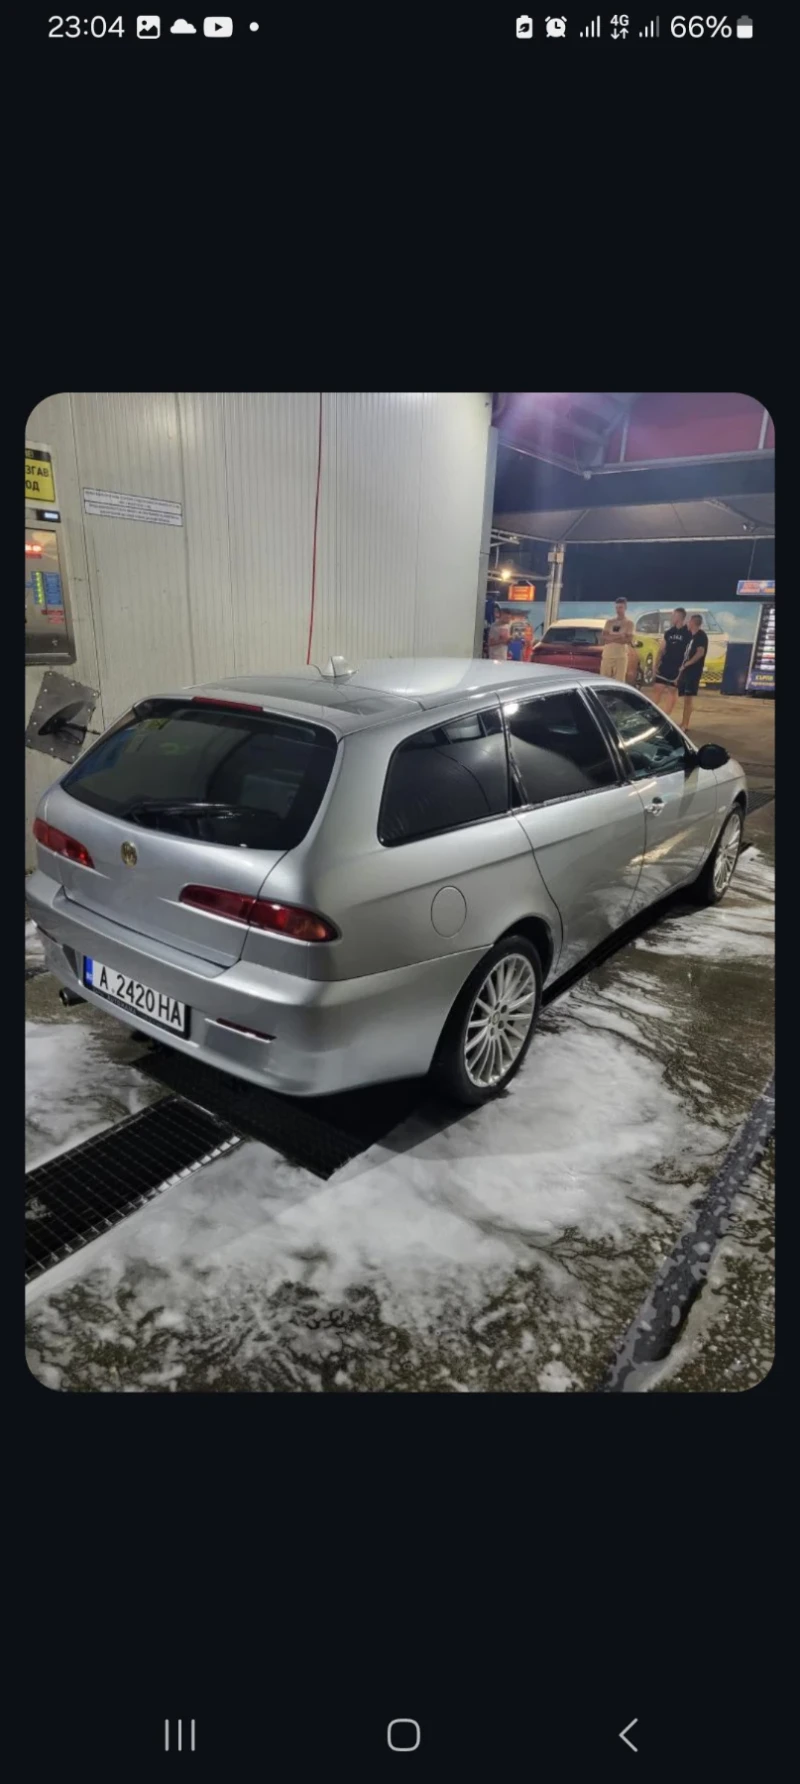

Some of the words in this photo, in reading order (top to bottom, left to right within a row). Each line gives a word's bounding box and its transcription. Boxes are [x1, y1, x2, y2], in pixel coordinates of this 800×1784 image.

[100, 966, 109, 990] A
[116, 974, 155, 1013] 2420
[159, 993, 183, 1027] HA
